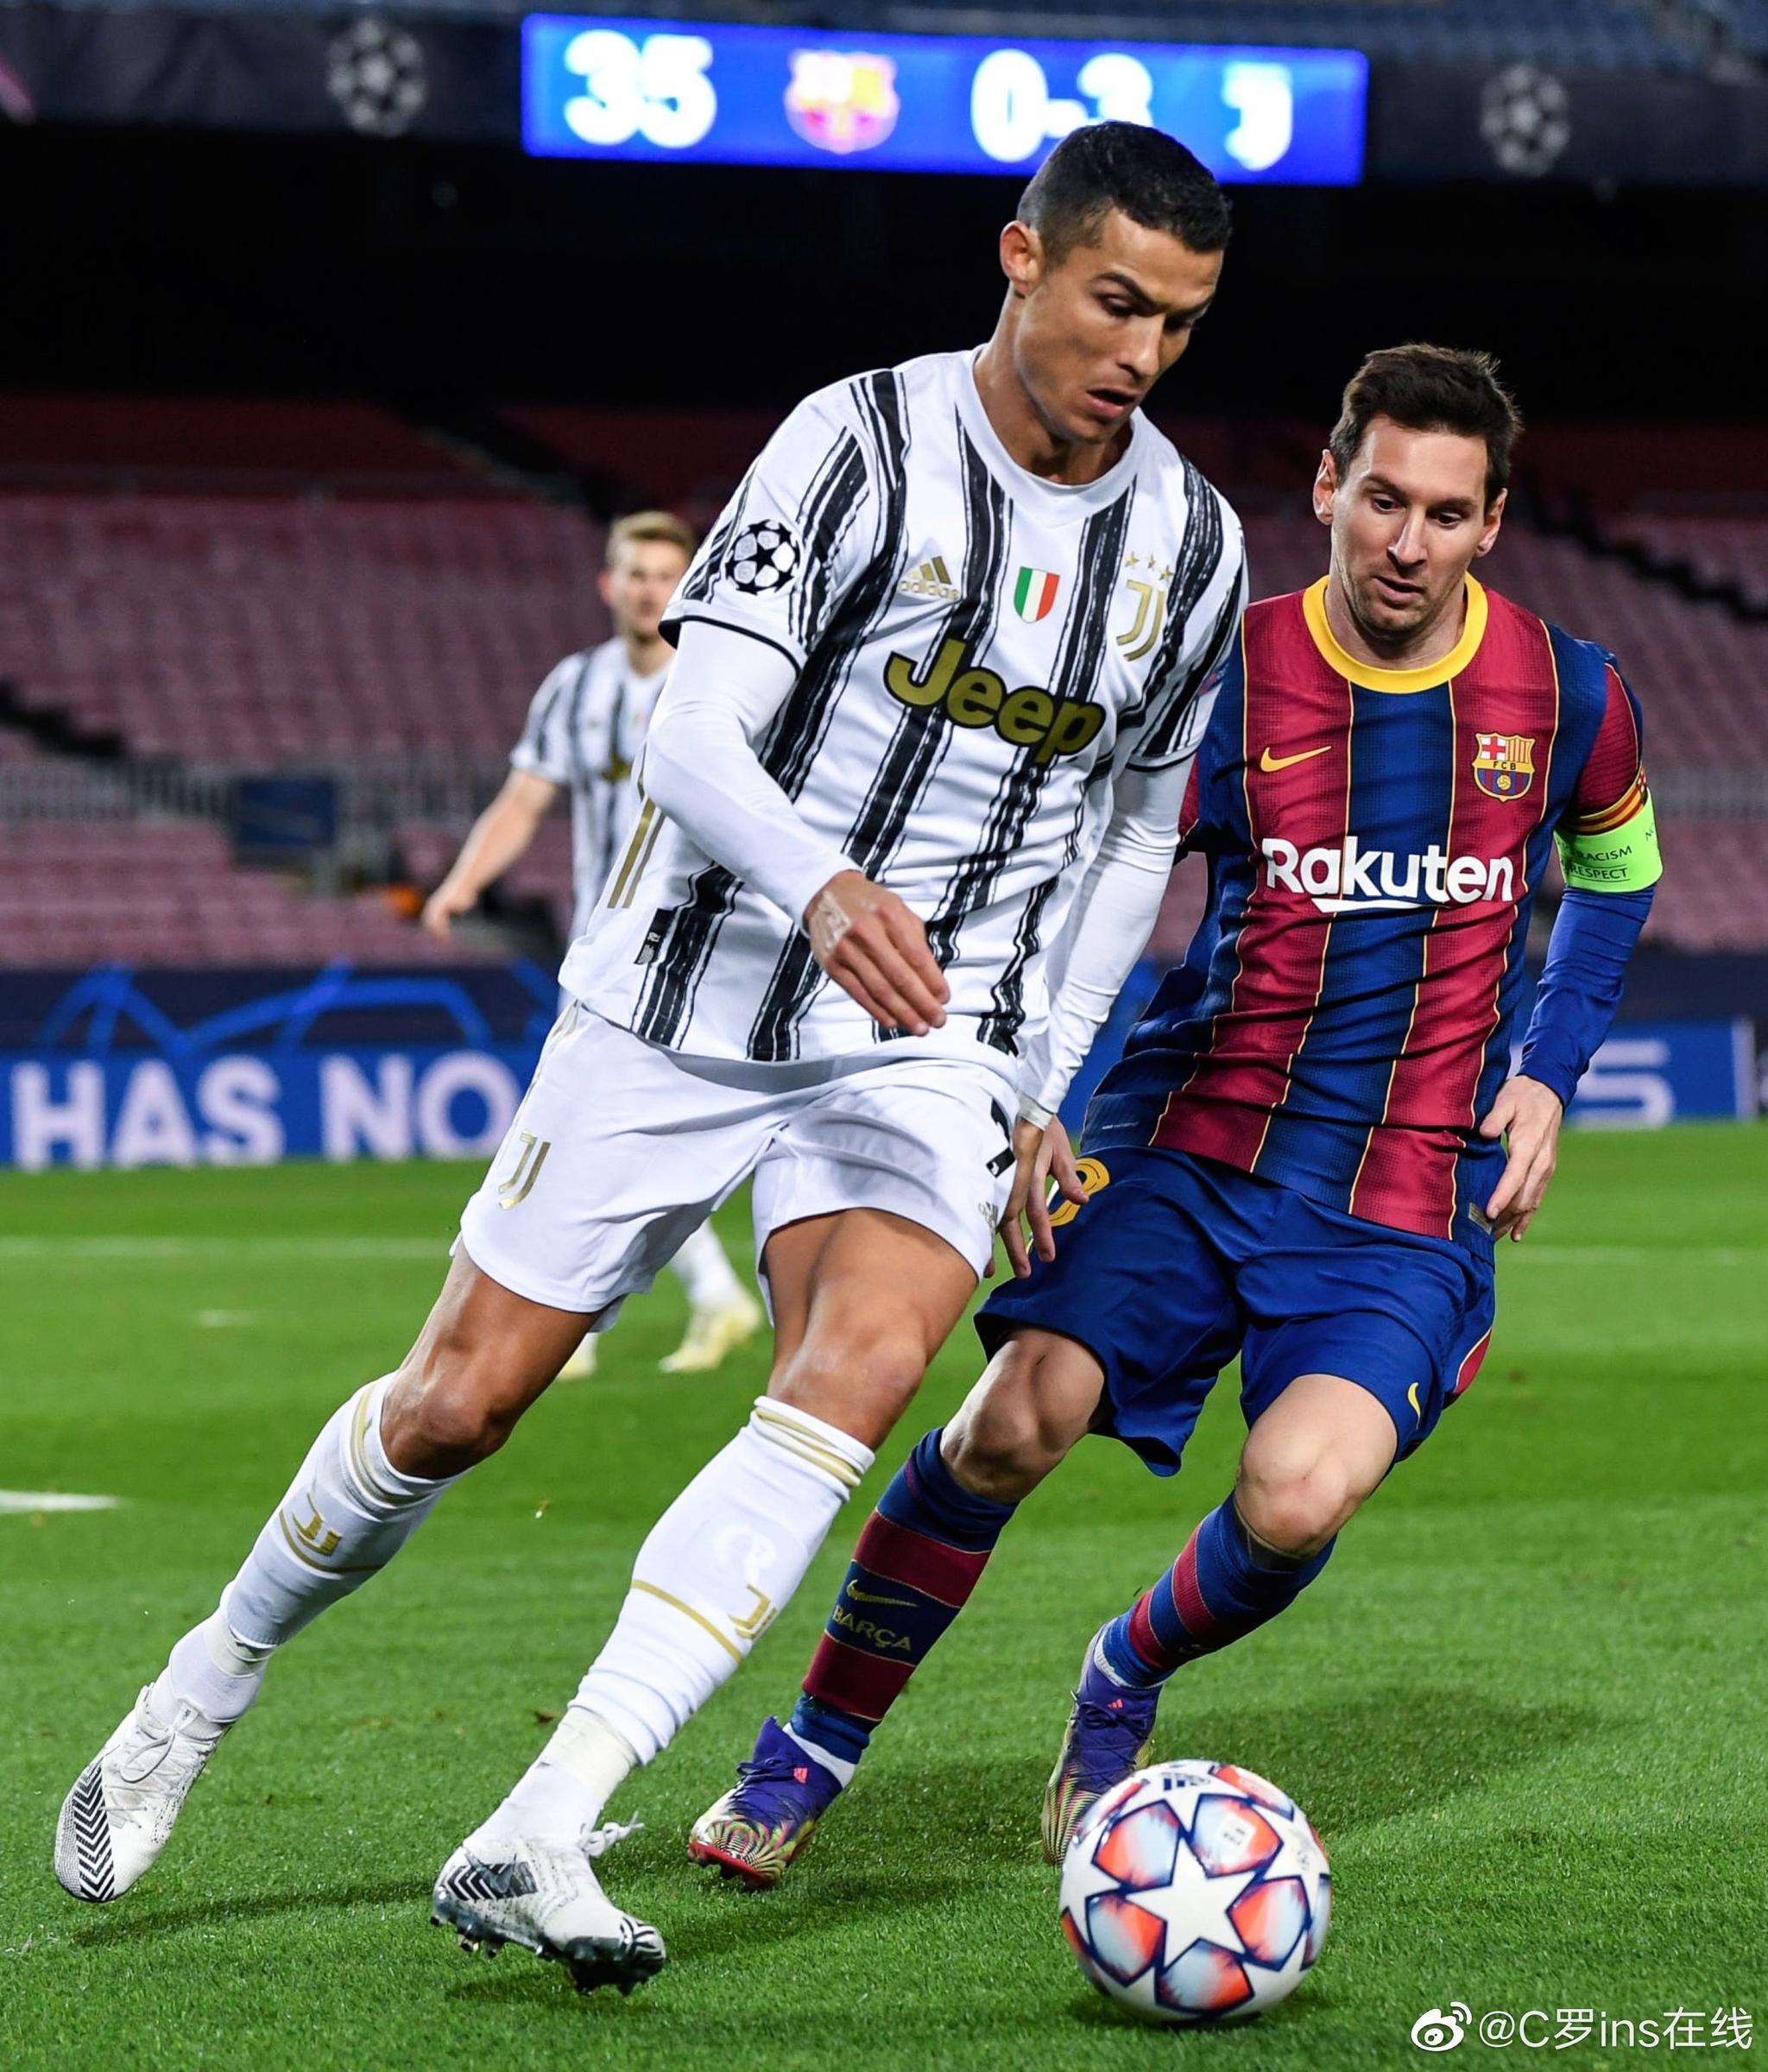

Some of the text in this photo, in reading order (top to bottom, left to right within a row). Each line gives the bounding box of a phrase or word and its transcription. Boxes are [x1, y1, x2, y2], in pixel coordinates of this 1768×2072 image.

[565, 28, 717, 148] 35
[883, 636, 1106, 764] Jeep
[1493, 761, 1517, 770] FCB
[1261, 836, 1514, 904] Rakuten
[1569, 864, 1629, 880] RESPECT
[12, 1052, 520, 1172] HAS NO
[832, 1604, 912, 1652] BARÇA
